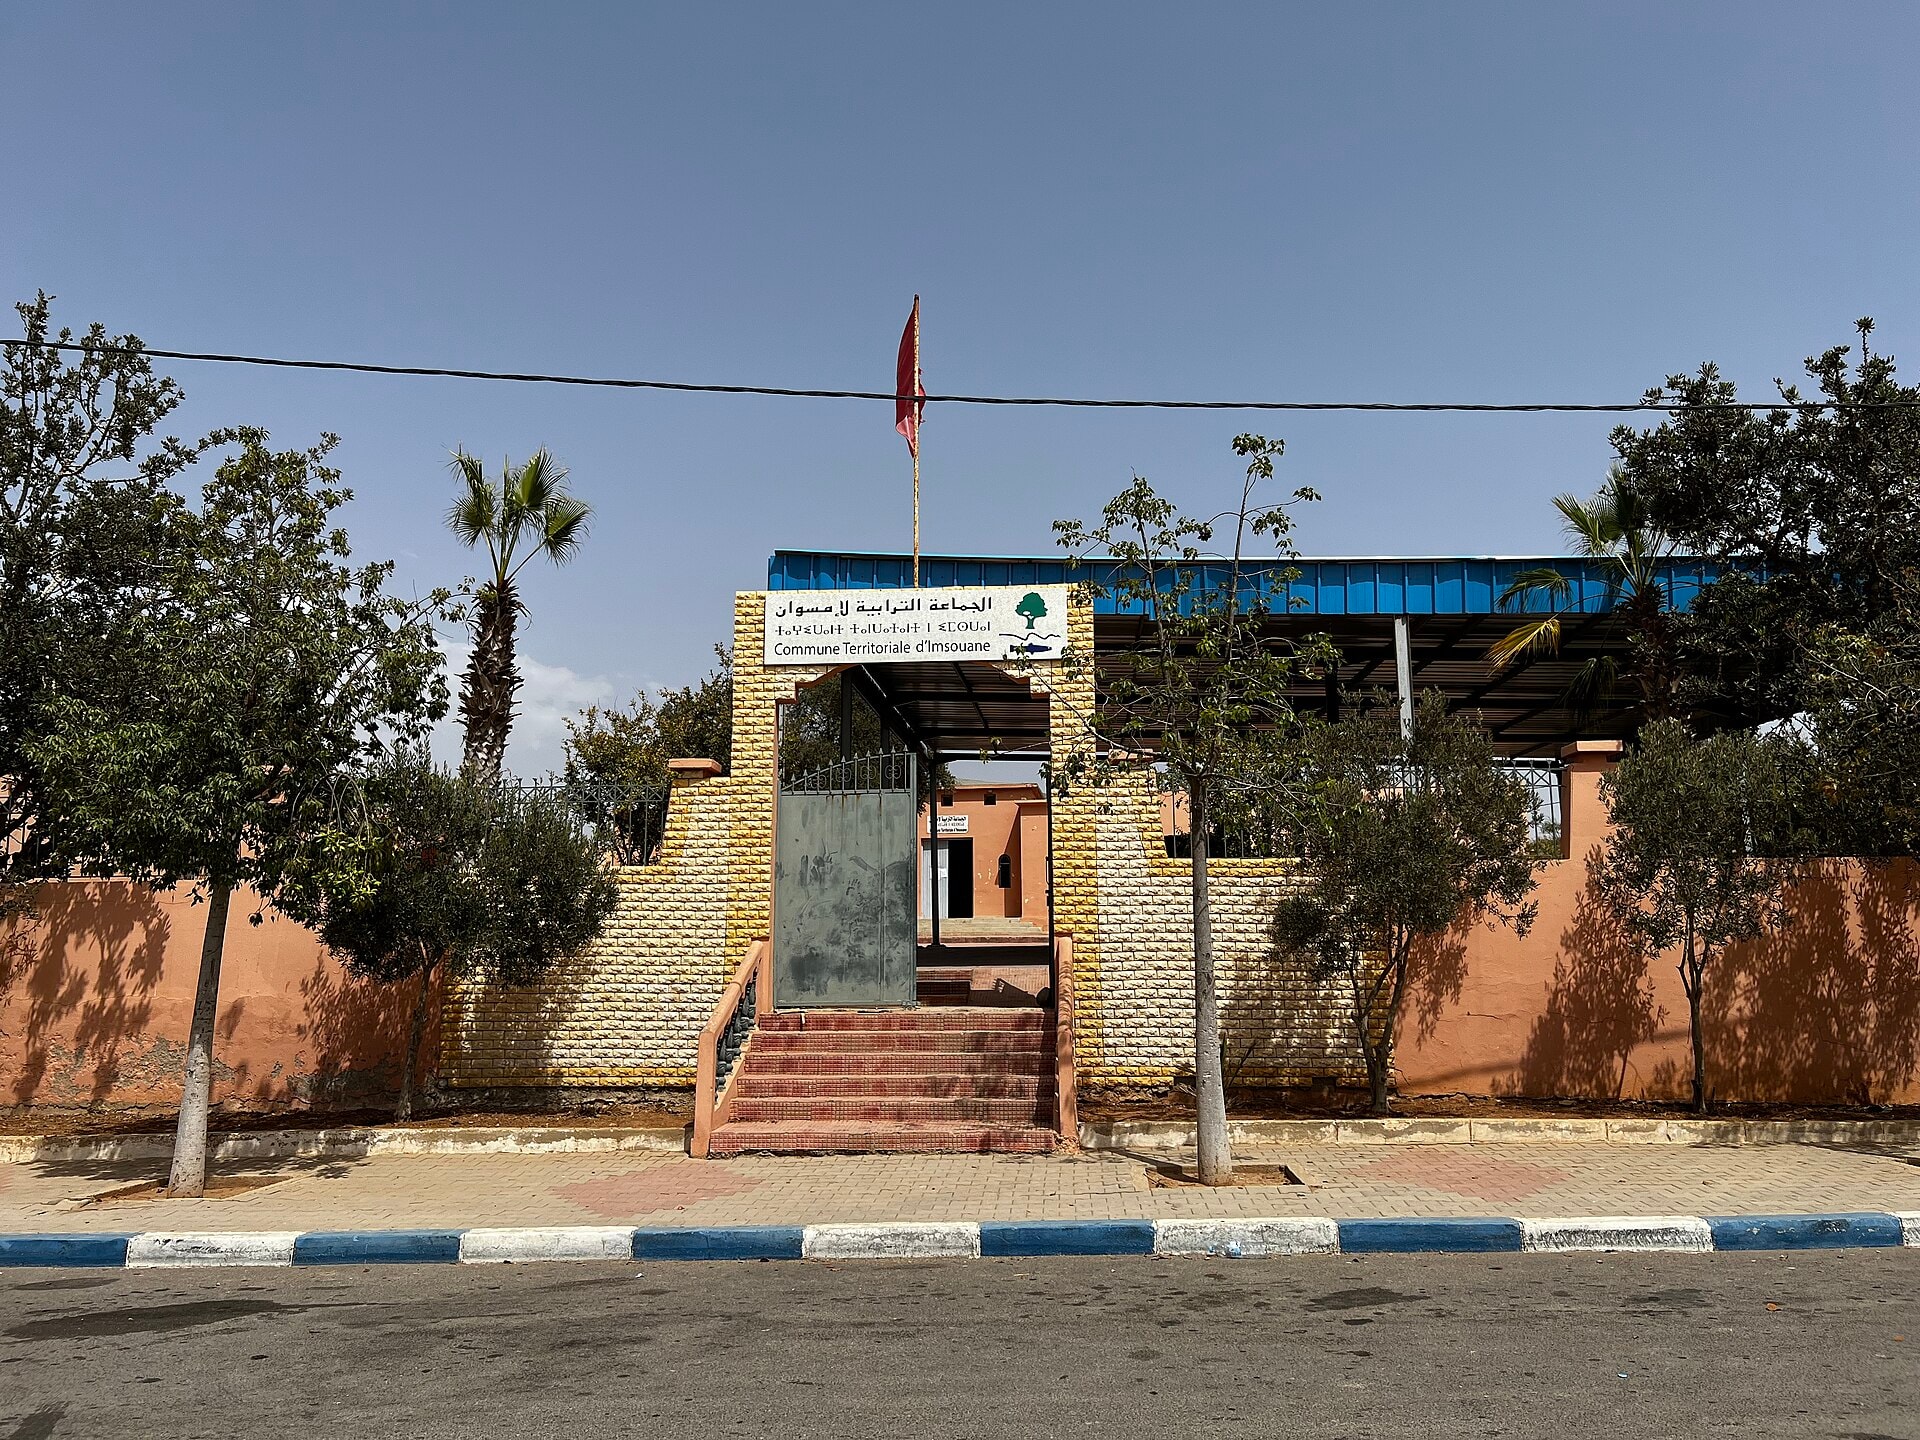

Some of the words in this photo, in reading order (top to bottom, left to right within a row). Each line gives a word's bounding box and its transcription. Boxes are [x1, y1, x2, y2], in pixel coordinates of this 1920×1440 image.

[775, 600, 849, 617] لإمسوان
[856, 597, 921, 617] الترابية
[929, 596, 992, 613] الجماعة
[774, 642, 840, 656] Commune
[842, 640, 911, 655] Territoriale
[915, 639, 991, 653] d’Imsouane
